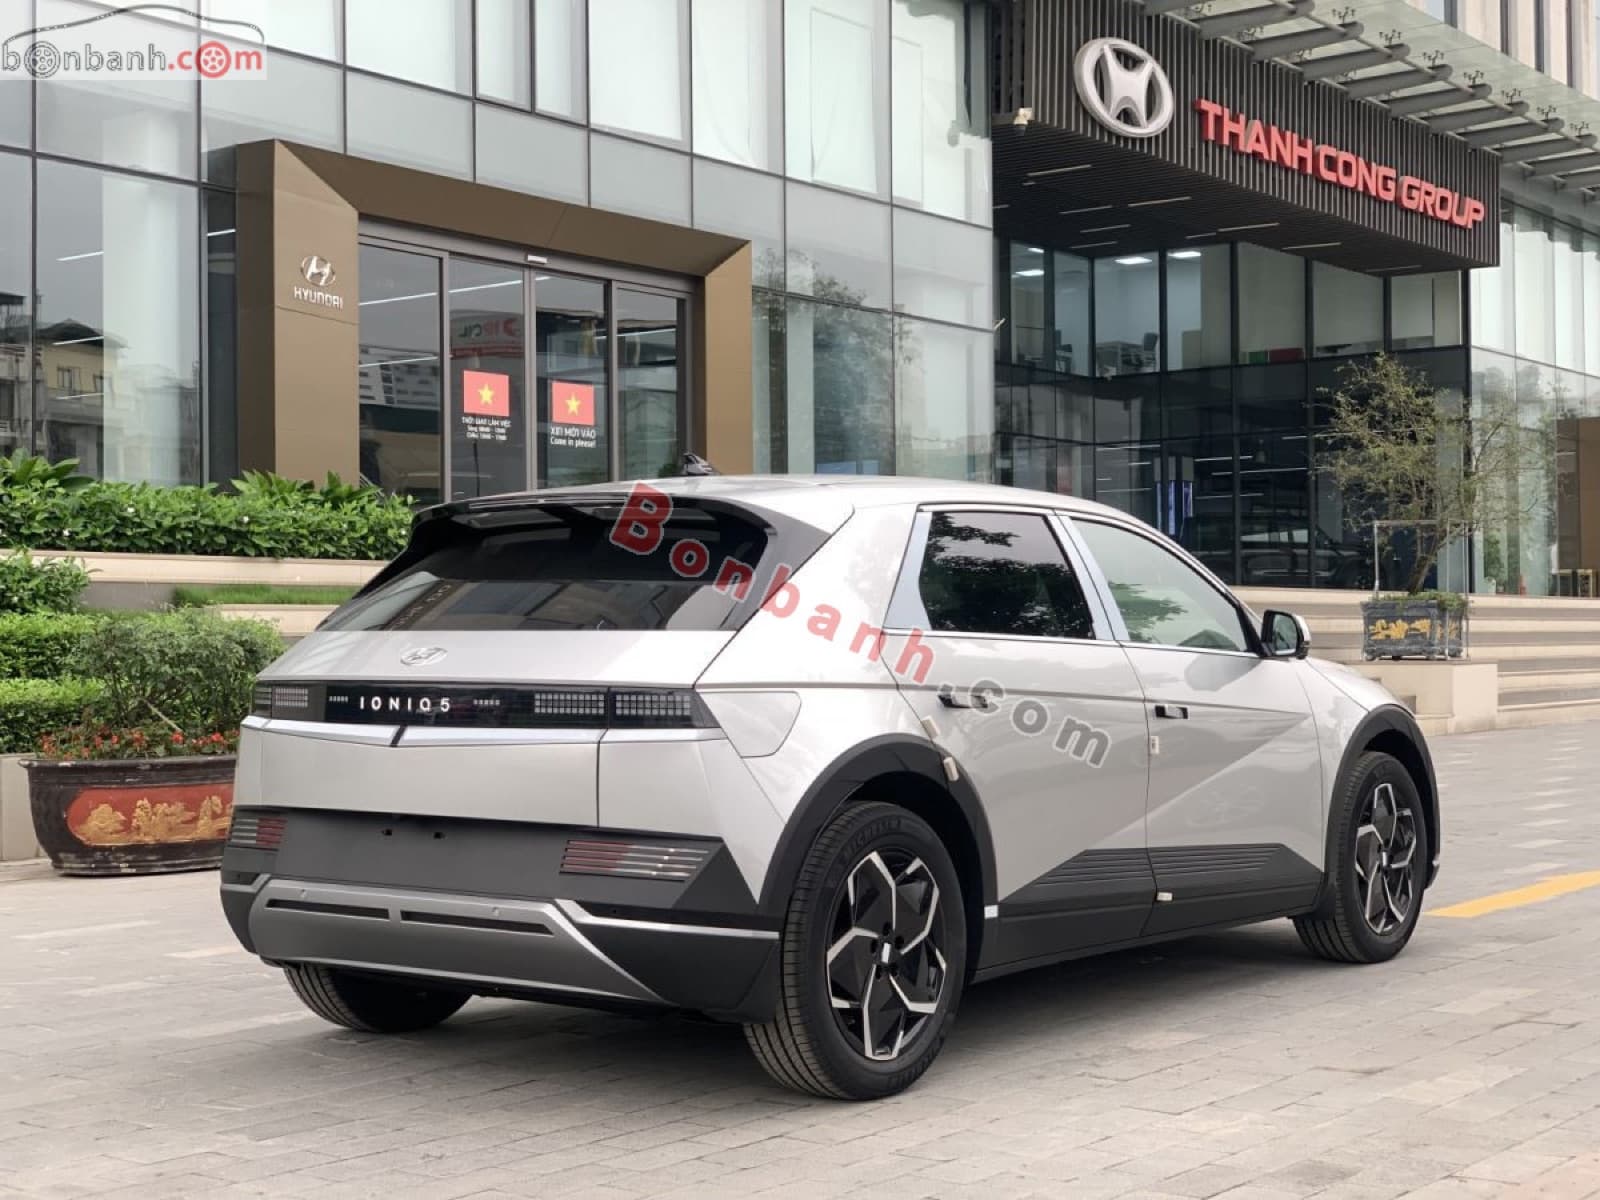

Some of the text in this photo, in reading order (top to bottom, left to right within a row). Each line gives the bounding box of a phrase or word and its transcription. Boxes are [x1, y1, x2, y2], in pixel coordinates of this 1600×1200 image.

[1194, 98, 1485, 229] THANH CONG GROUP
[294, 286, 344, 312] HYUNDAI
[359, 696, 451, 713] IONIQ 5
